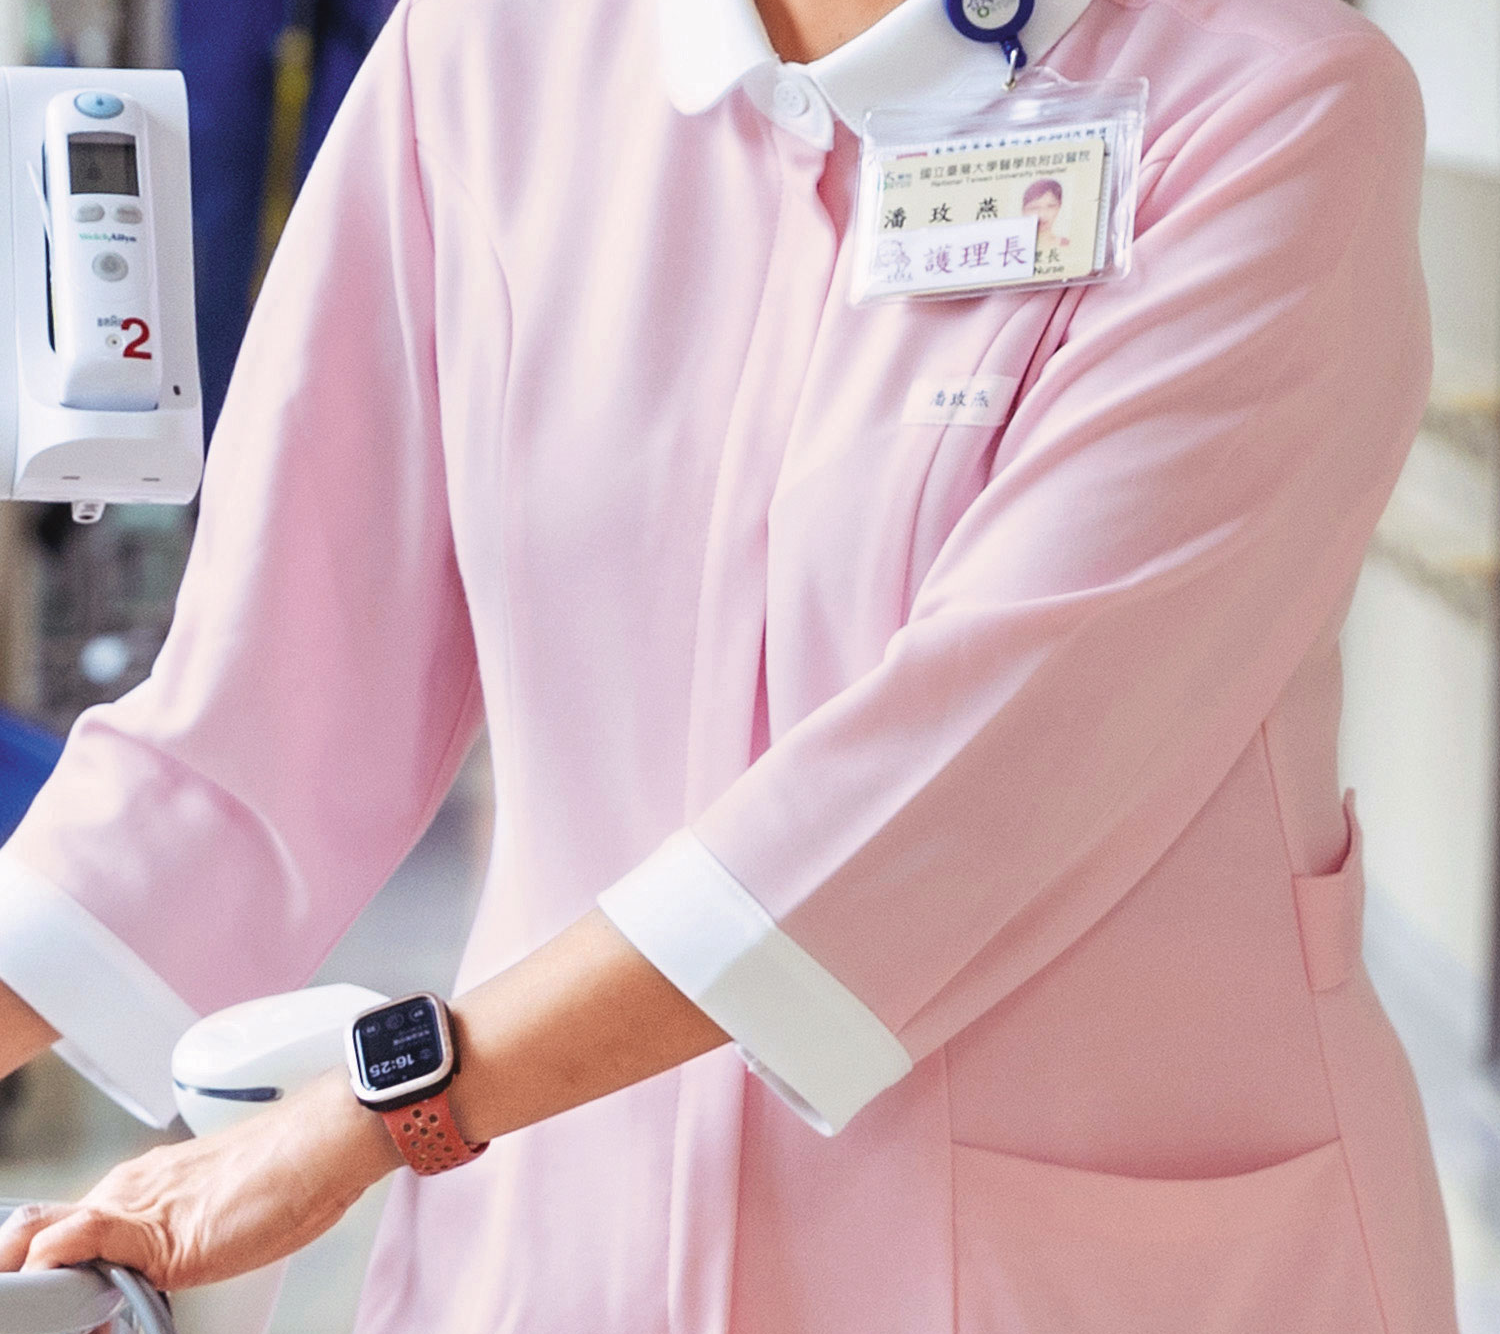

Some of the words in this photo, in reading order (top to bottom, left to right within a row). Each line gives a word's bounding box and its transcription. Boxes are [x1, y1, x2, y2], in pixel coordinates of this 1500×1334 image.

[923, 235, 1027, 275] 護理長
[121, 317, 152, 360] 2
[369, 1053, 416, 1078] 16:25
